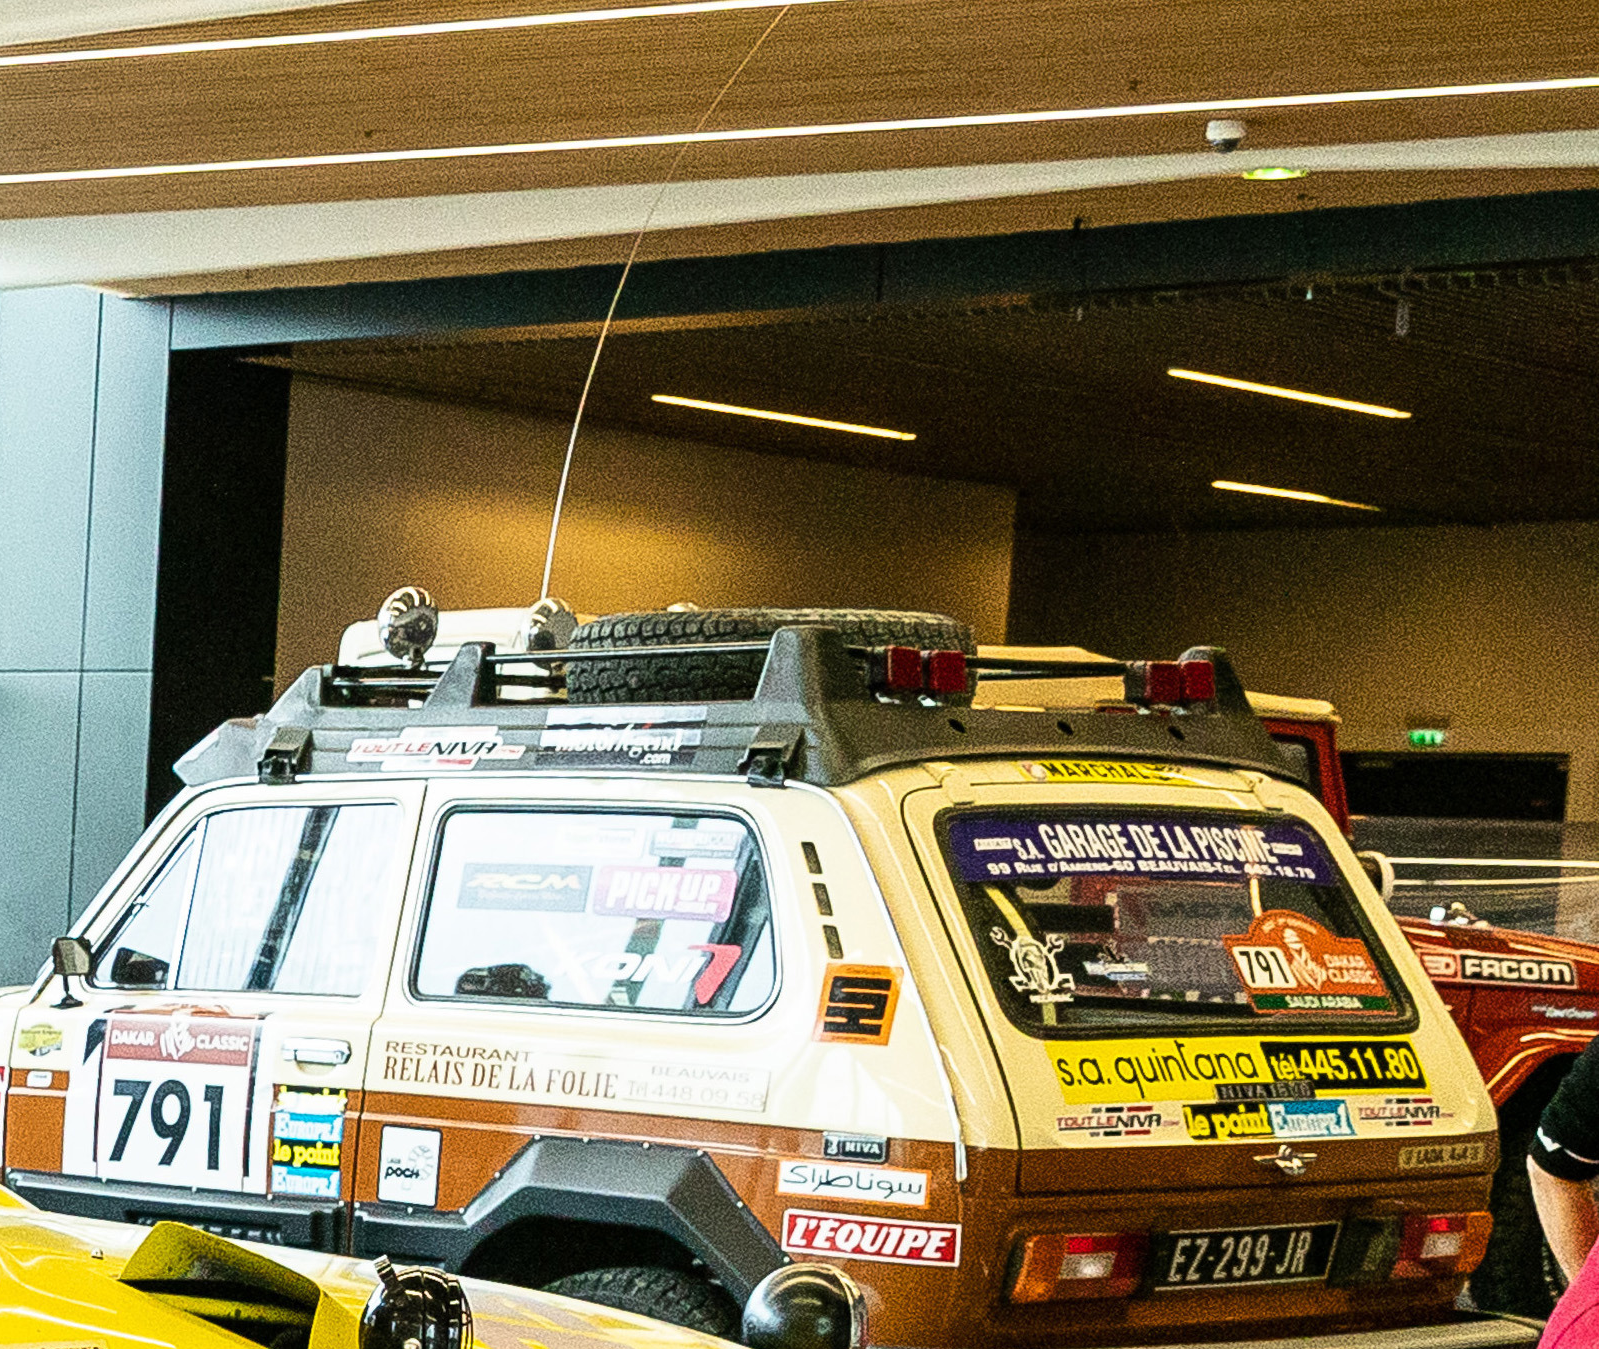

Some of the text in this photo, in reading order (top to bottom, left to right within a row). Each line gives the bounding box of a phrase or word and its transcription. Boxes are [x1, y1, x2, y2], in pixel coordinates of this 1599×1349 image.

[1043, 761, 1149, 780] MARCHAL
[1038, 823, 1130, 860] GARAGE
[1128, 824, 1169, 859] DE
[1168, 825, 1199, 860] LA
[1194, 826, 1279, 865] PISCINE
[1239, 950, 1290, 984] 791
[1323, 954, 1365, 969] DAKAR
[1464, 958, 1573, 983] FACOM
[1326, 968, 1377, 985] CLASSIC
[110, 1028, 250, 1053] DAKAR CLASSIC
[385, 1040, 531, 1064] RESTAURANT
[383, 1056, 619, 1099] RELAIS DE LA FOLIE
[650, 1065, 751, 1084] BEAUVAIS
[1056, 1056, 1112, 1087] s.a.
[1113, 1040, 1260, 1099] quintana
[698, 1086, 729, 1105] 09
[109, 1078, 225, 1171] 791
[1056, 1115, 1096, 1129] TOUT
[1211, 1104, 1271, 1139] point
[272, 1139, 341, 1168] le point
[844, 1141, 881, 1155] NIVA
[788, 1215, 955, 1260] L'ÉQUIPE
[1166, 1230, 1313, 1284] EZ-299-JR
